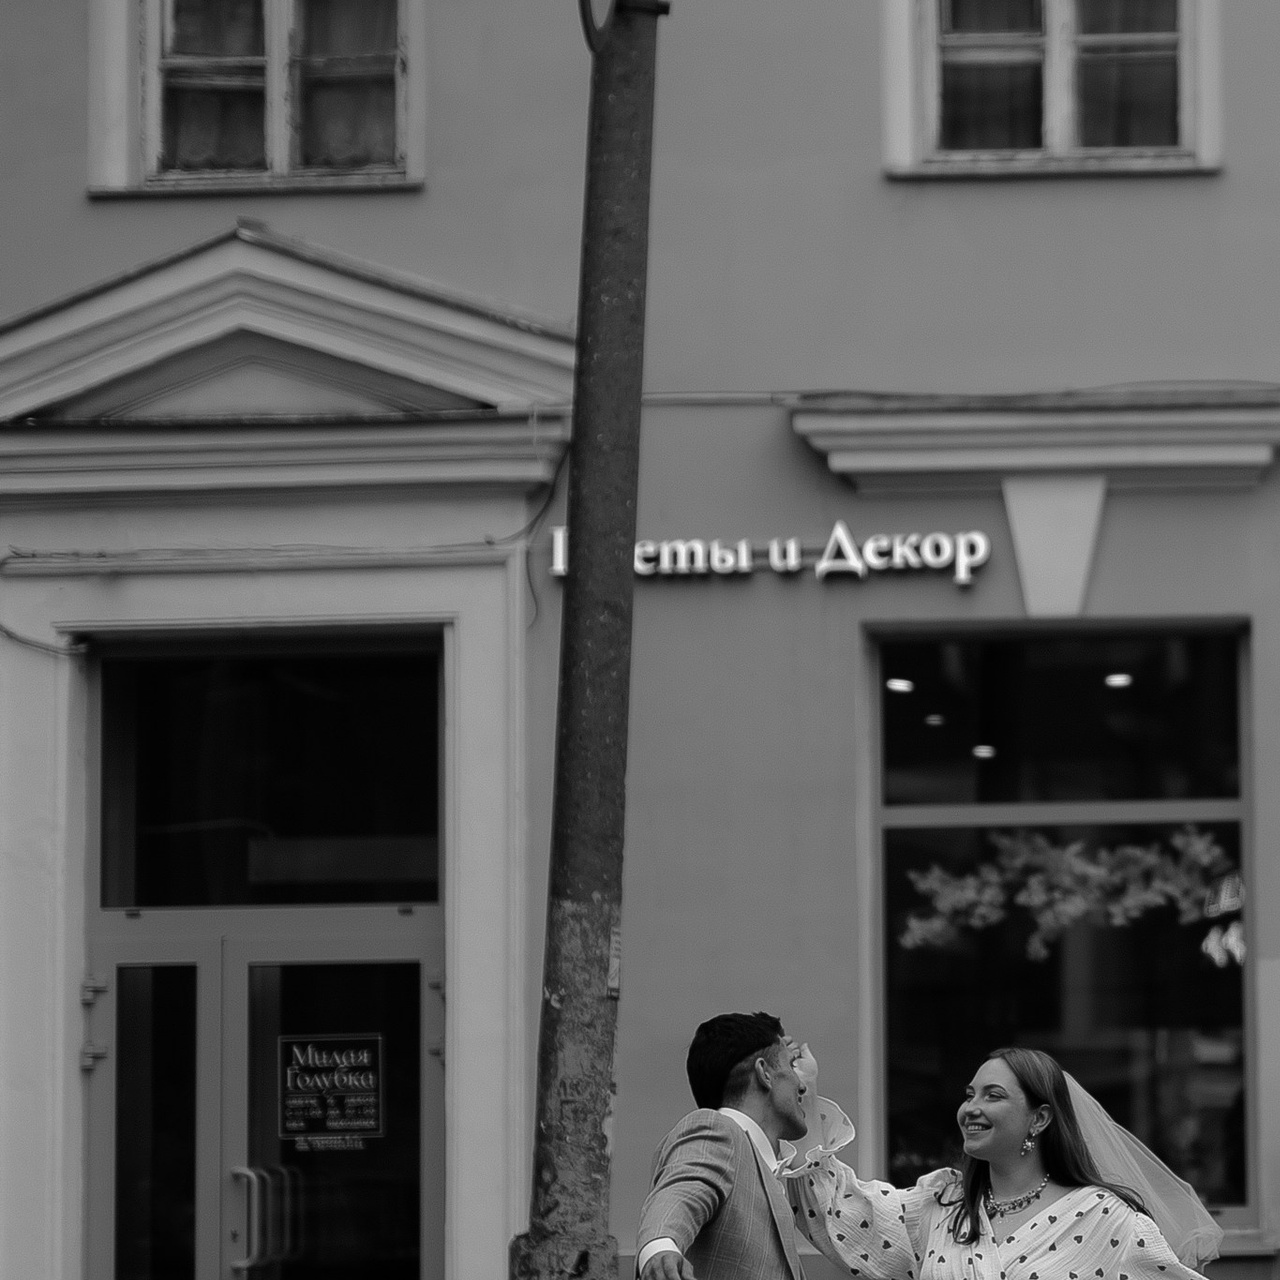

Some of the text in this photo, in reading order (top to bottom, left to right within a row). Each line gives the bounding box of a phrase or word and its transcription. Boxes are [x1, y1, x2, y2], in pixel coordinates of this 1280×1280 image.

[549, 519, 992, 585] еты и Декор
[292, 1043, 371, 1068] Милая
[286, 1065, 376, 1093] Голубка
